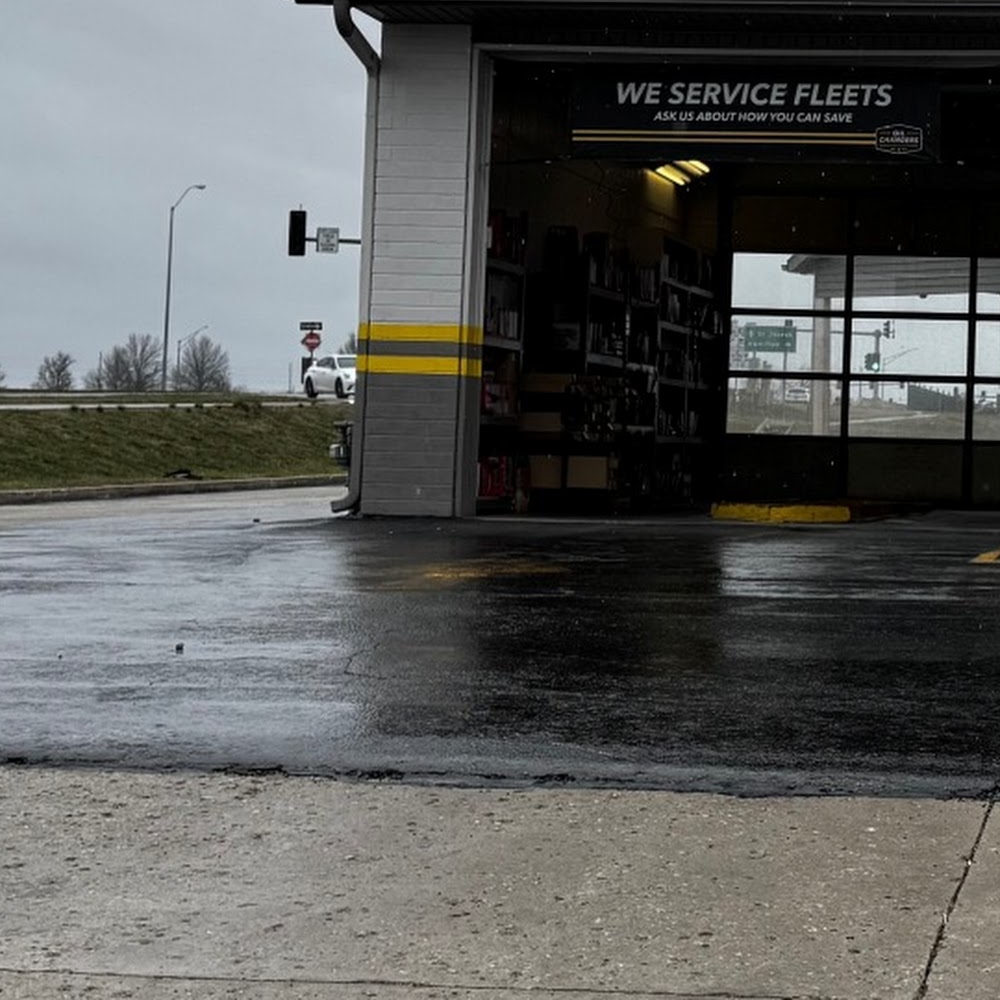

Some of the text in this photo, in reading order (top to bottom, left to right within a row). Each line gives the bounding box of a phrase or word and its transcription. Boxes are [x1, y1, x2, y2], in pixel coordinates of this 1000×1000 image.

[616, 82, 893, 108] WE SERVICE FLEETS
[654, 111, 853, 124] ASK US ABOUT HOW YOU CAN SAVE
